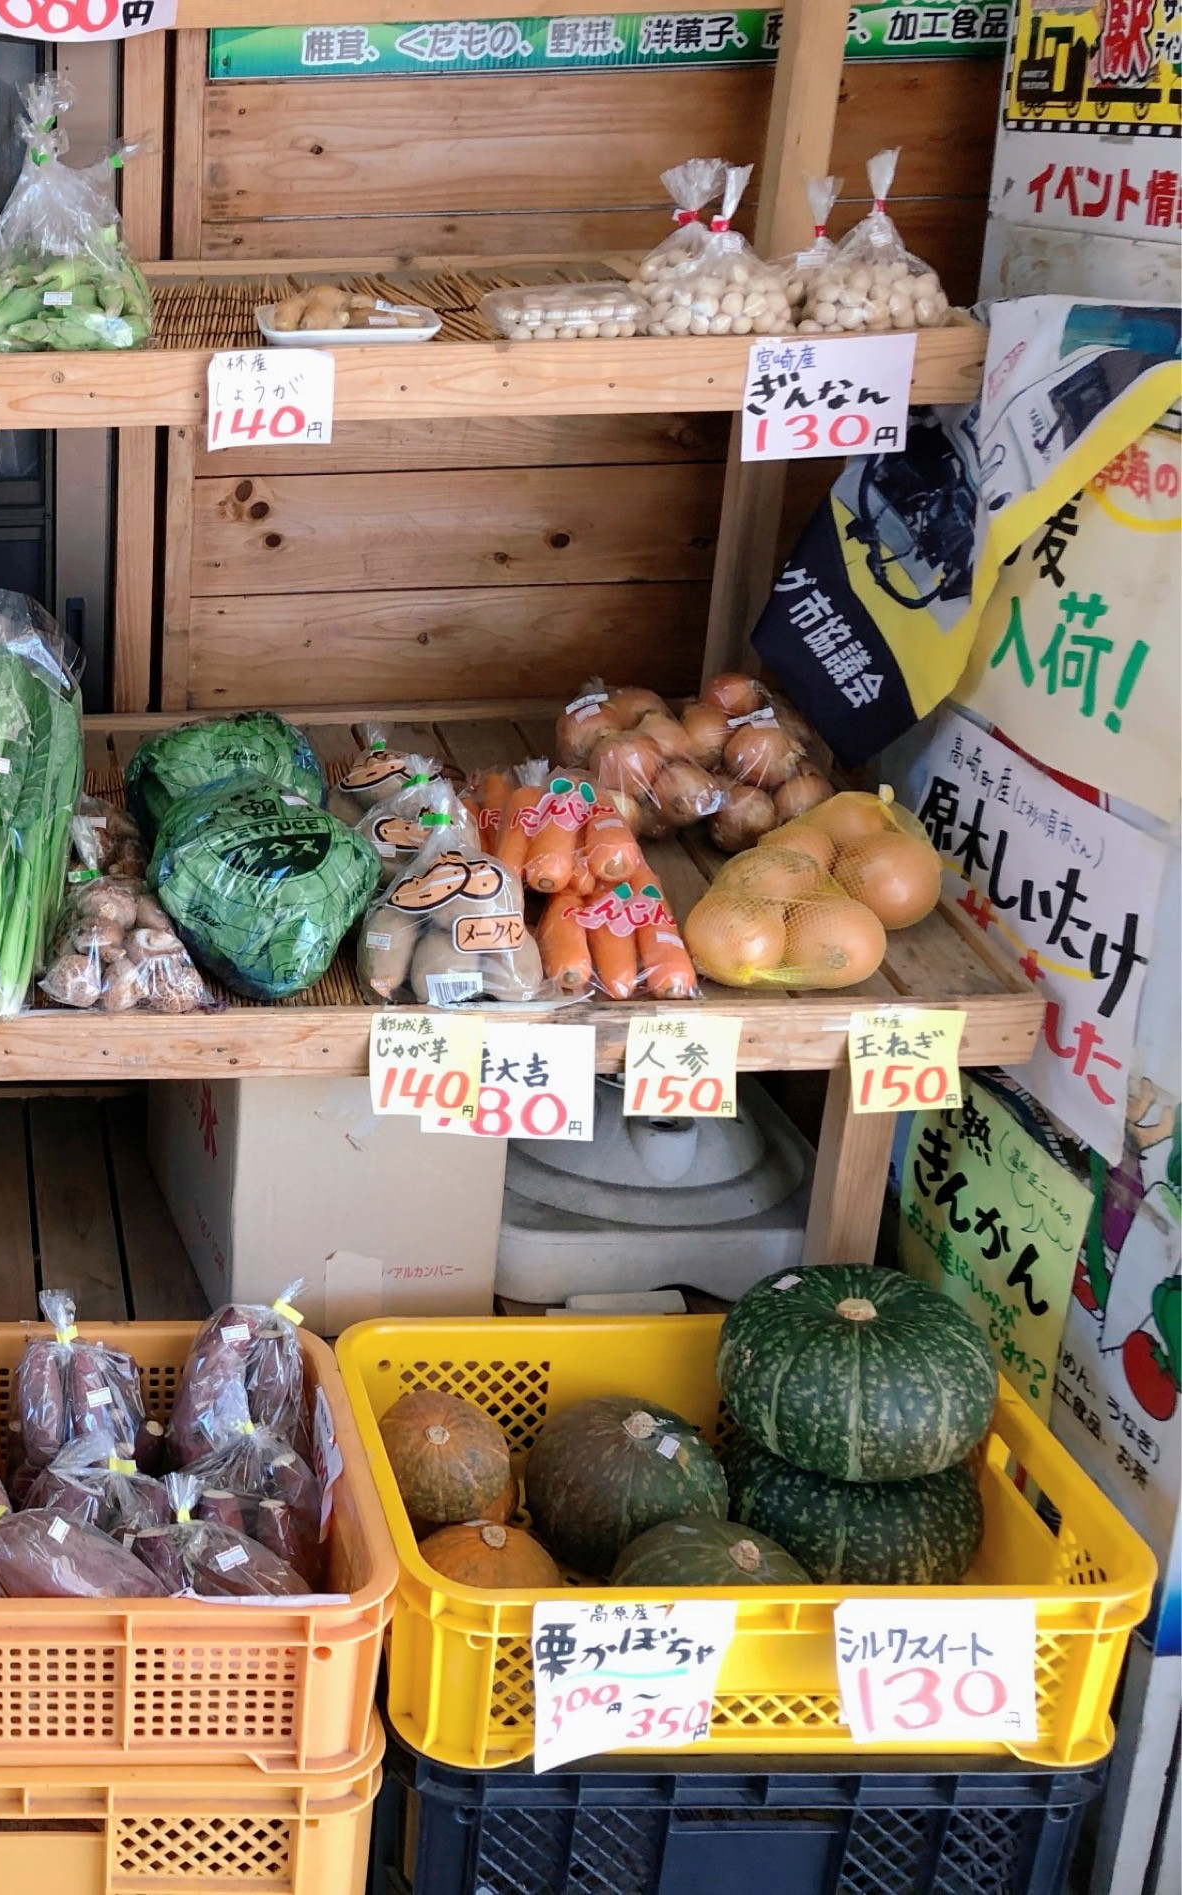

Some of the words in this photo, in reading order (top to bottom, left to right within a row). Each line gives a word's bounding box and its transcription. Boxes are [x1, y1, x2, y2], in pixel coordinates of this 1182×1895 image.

[1028, 162, 1182, 228] イベント情
[757, 344, 817, 372] 宮崎産
[216, 376, 304, 406] しょうが
[212, 405, 322, 442] 140円
[756, 414, 899, 452] 130円
[376, 1037, 449, 1064] じゃが芋
[633, 1041, 709, 1078] 人参
[854, 1029, 946, 1060] 玉ねぎ
[379, 1067, 474, 1118] 140円
[632, 1075, 733, 1113] 150円
[860, 1064, 959, 1107] 150円
[535, 1622, 715, 1681] 栗かぼちゃ
